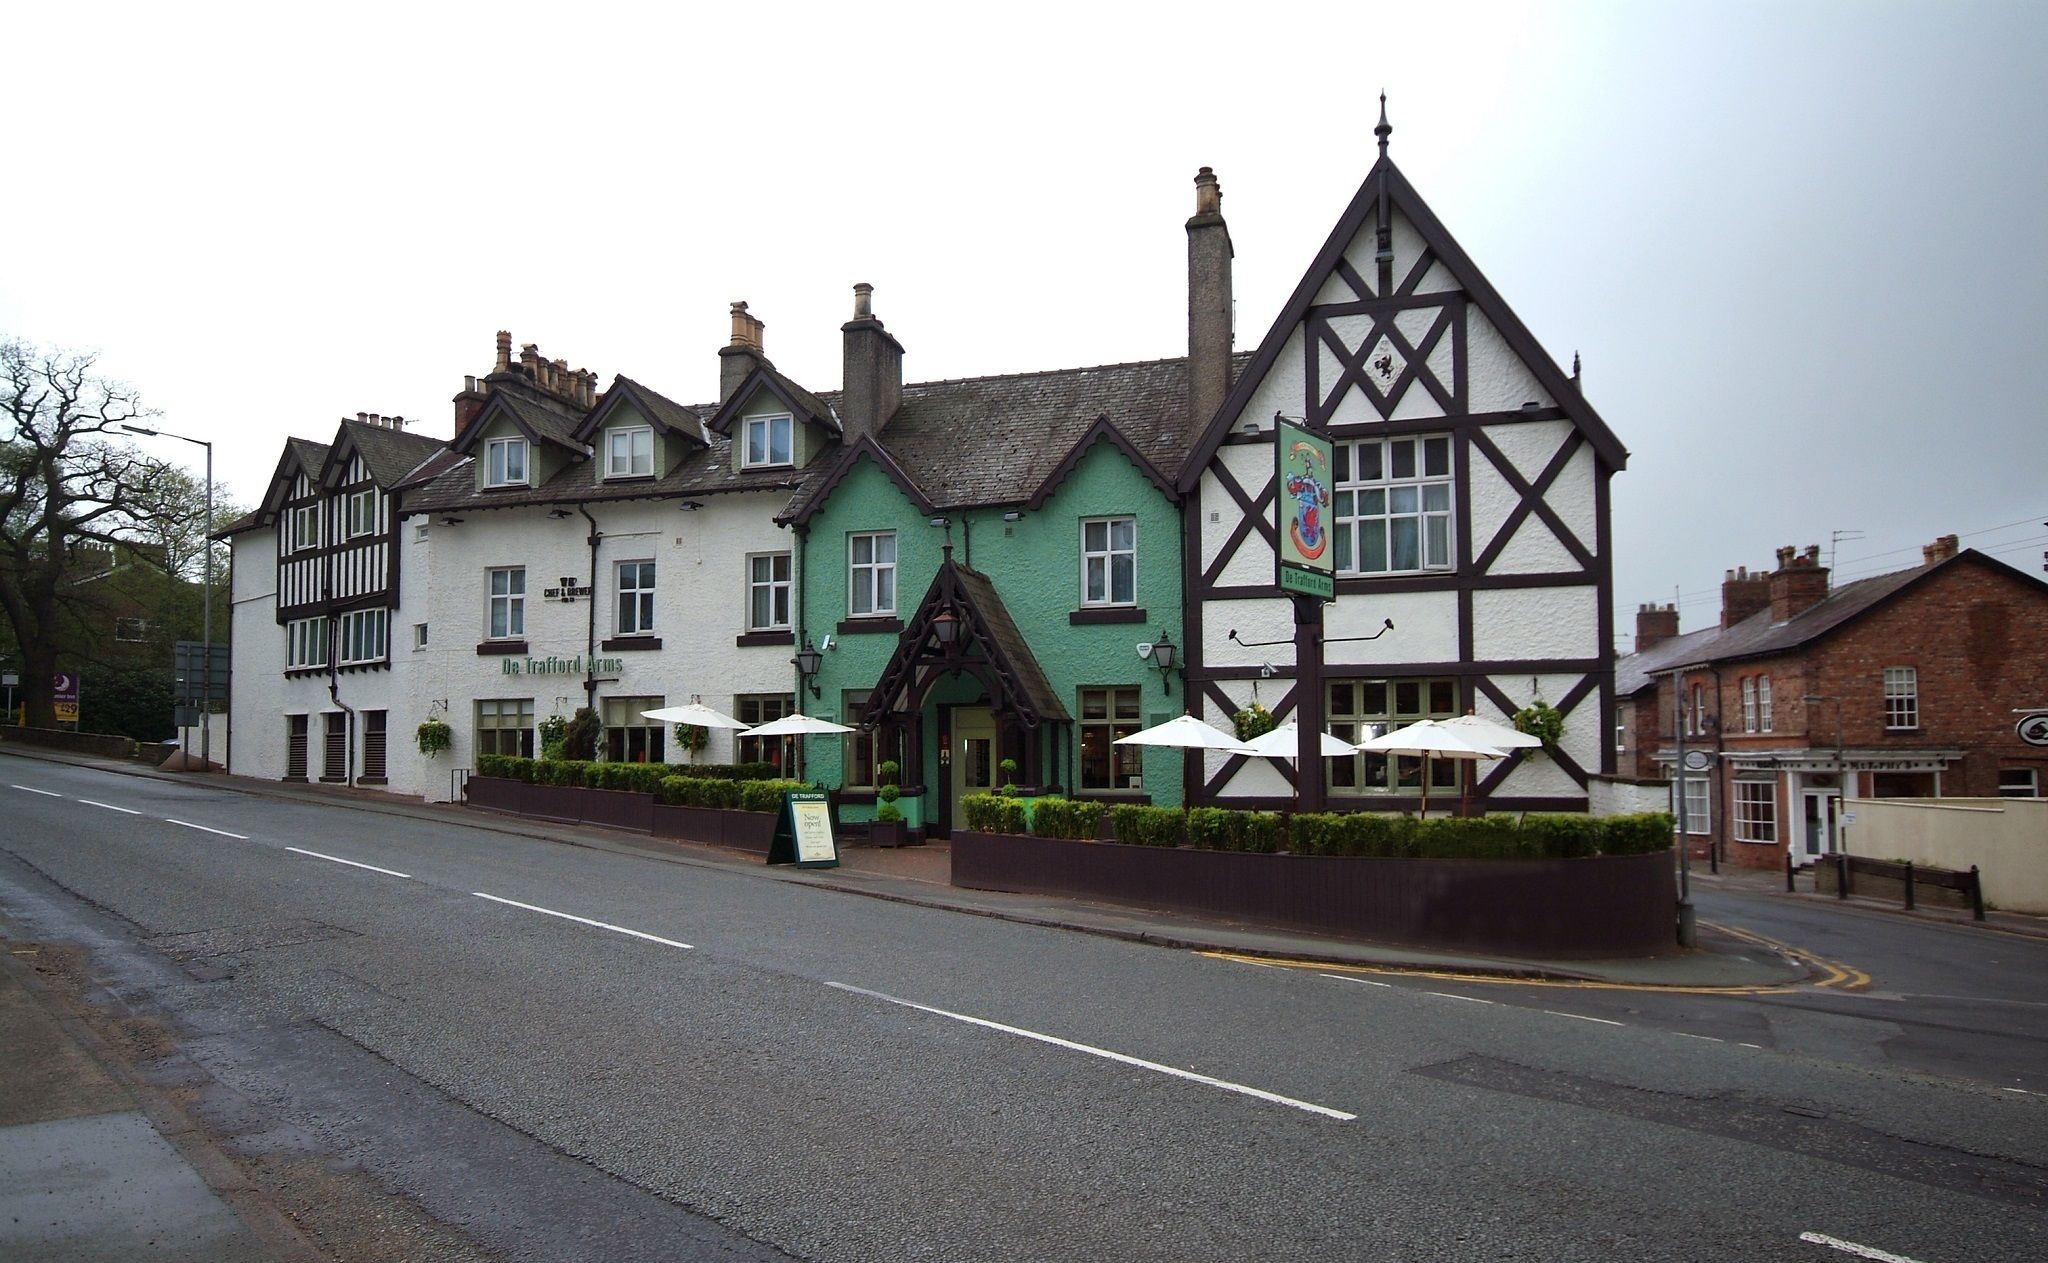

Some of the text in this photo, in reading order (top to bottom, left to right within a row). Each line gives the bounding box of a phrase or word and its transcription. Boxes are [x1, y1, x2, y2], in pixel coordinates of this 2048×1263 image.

[544, 588, 559, 597] CHEF
[561, 588, 566, 597] &
[502, 655, 623, 675] De Trafford Arms
